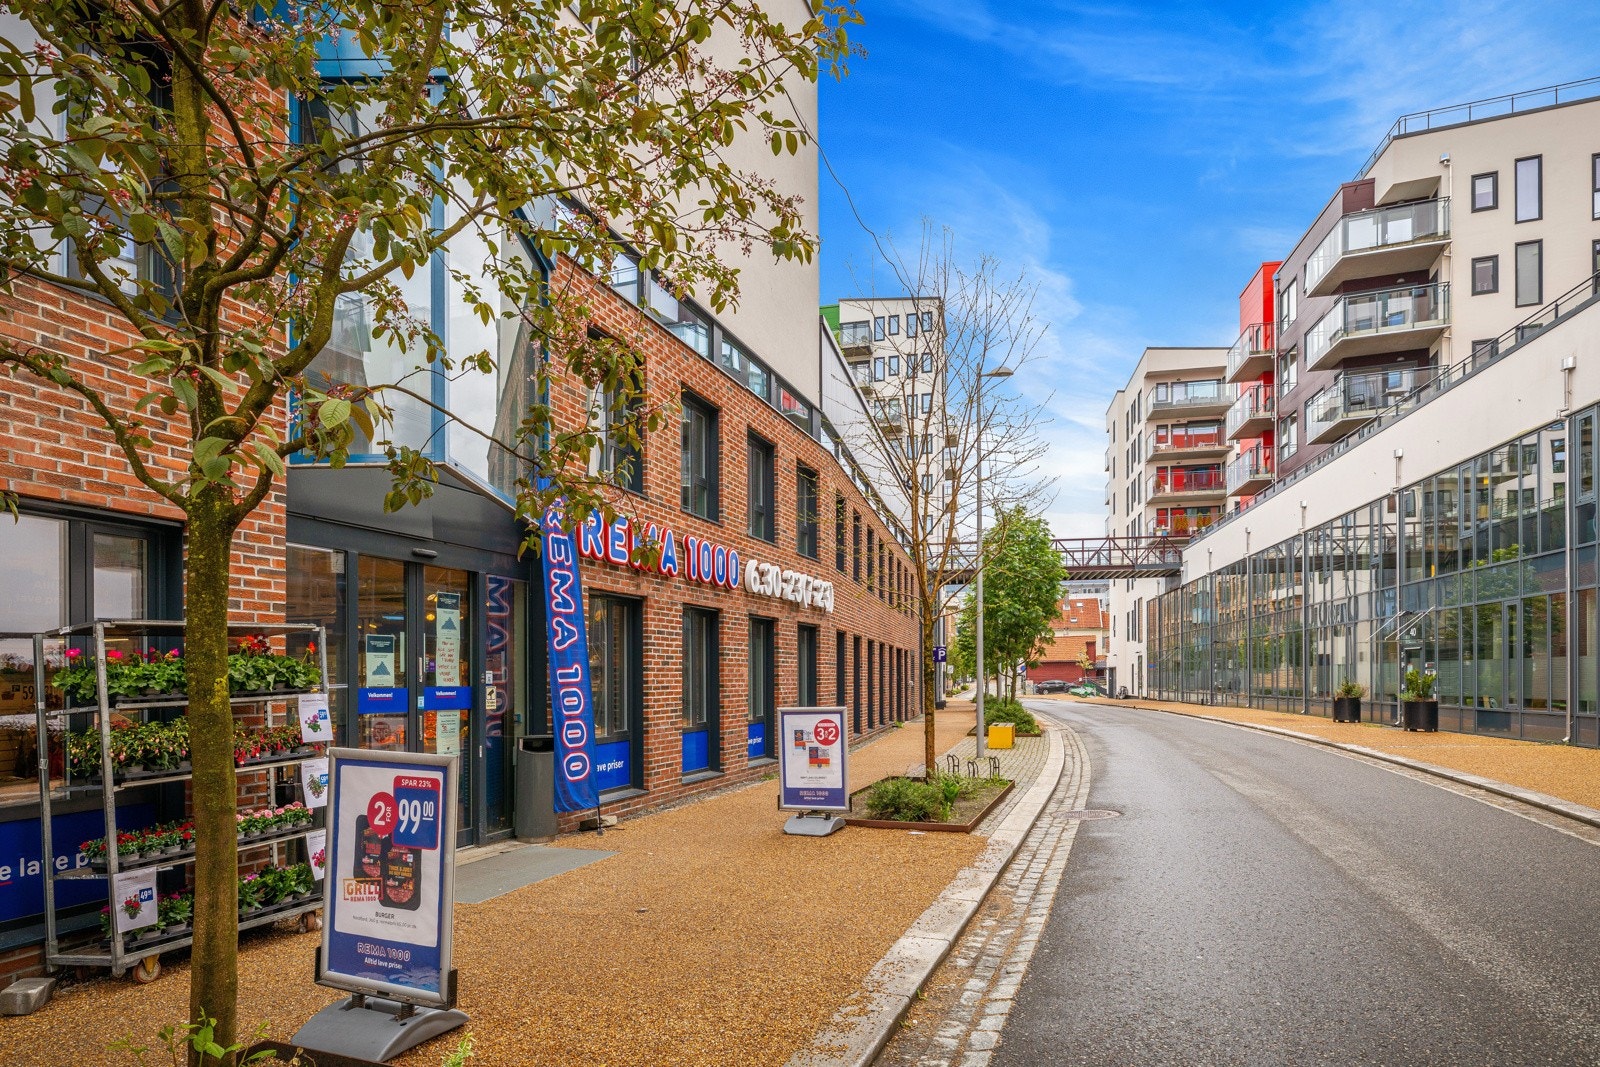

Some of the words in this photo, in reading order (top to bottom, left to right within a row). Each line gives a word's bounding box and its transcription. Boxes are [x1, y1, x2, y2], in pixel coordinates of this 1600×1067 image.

[576, 507, 679, 578] REMA
[683, 534, 740, 590] 1000
[546, 497, 578, 651] REMA
[1409, 627, 1417, 637] 40
[938, 650, 946, 660] P
[557, 664, 591, 783] 1000
[817, 728, 824, 741] 3
[828, 728, 836, 741] 2
[607, 759, 624, 773] priser
[401, 779, 418, 787] SPAR
[418, 780, 432, 788] 23%
[374, 801, 386, 826] 2
[20, 855, 69, 877] lae
[346, 881, 381, 896] GRILL
[375, 911, 395, 920] BURGER
[357, 942, 386, 958] REMA
[386, 947, 411, 962] 1000
[364, 956, 378, 966] Alltid
[377, 959, 388, 968] lave
[388, 961, 403, 970] priser
